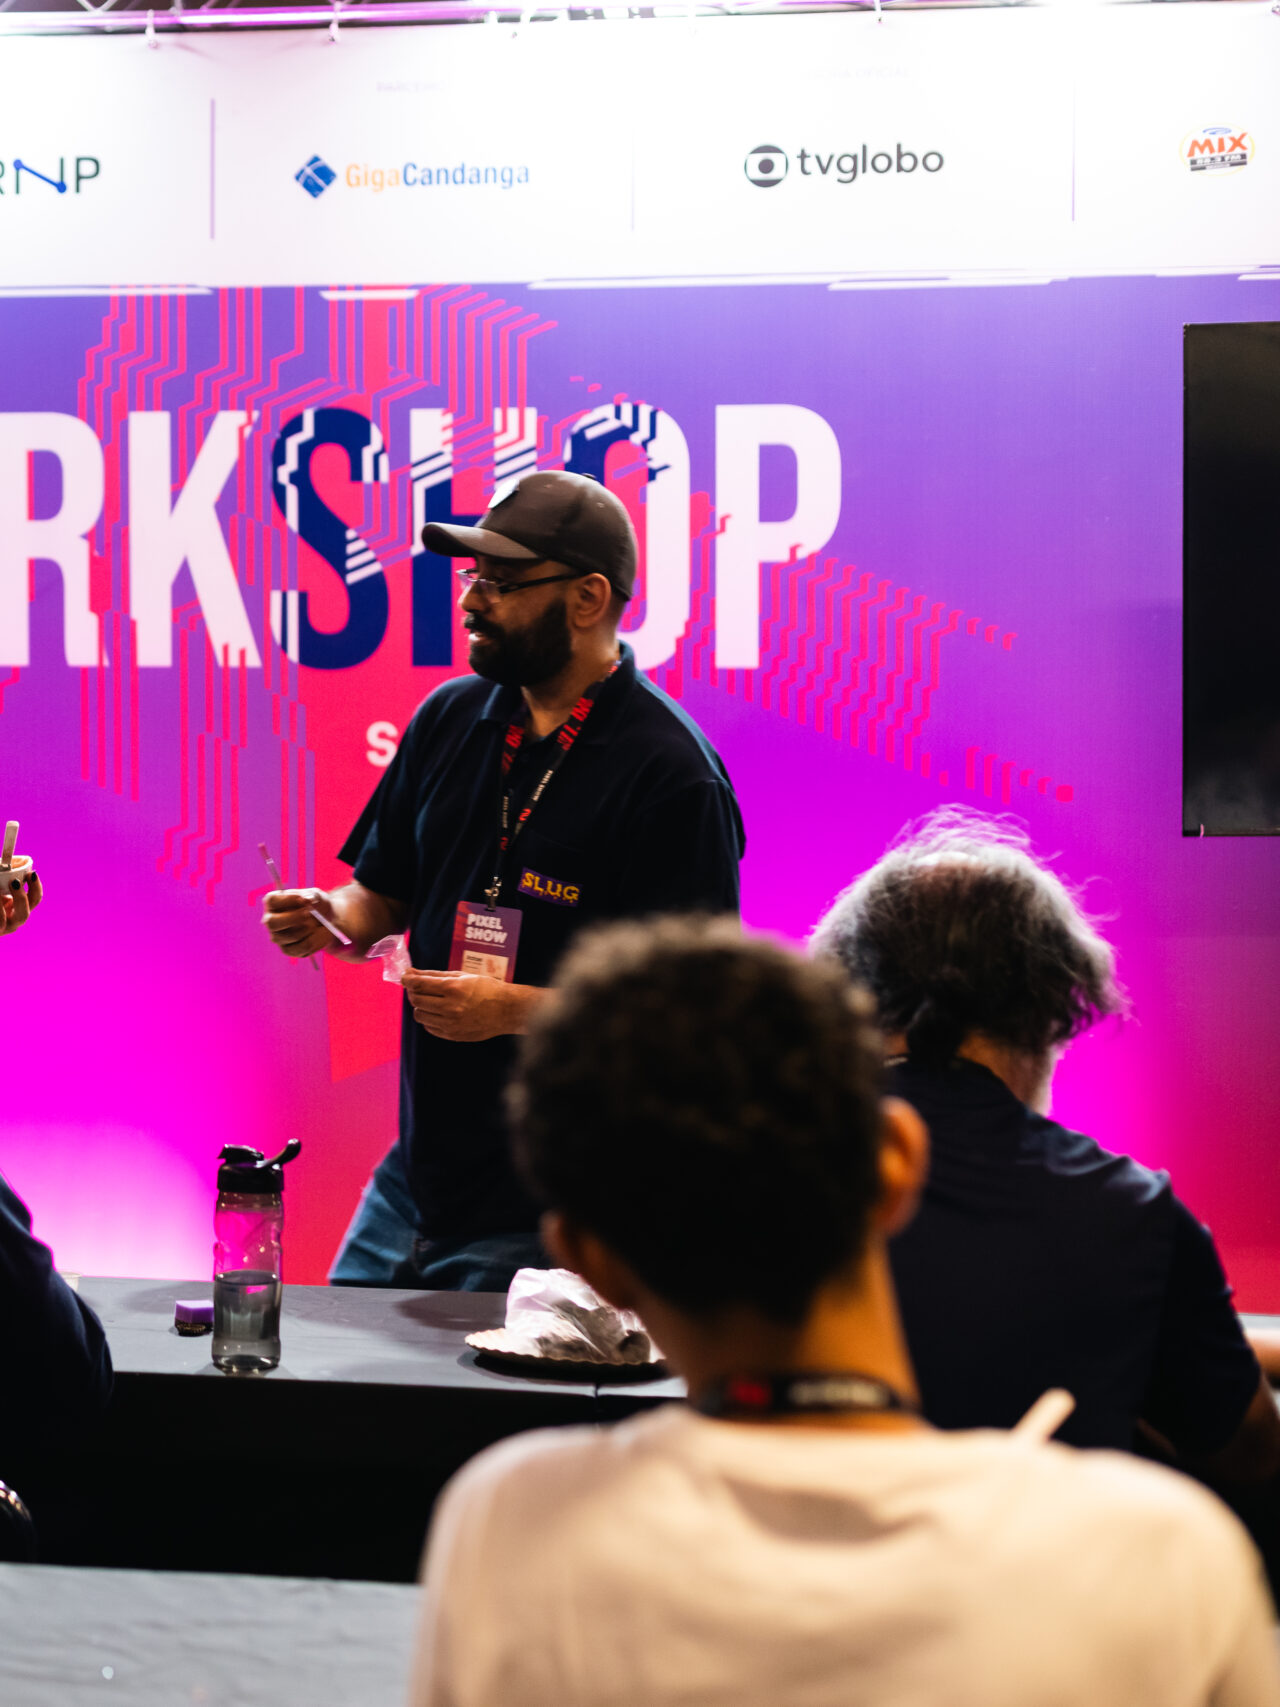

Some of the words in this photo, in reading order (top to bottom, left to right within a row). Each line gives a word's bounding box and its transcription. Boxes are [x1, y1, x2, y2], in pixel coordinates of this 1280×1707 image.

[1187, 132, 1248, 157] MIX
[345, 162, 530, 193] GigaCandanga
[797, 143, 944, 184] tvglobo
[521, 871, 581, 903] SLUG
[464, 926, 508, 944] SHOW
[467, 913, 504, 930] PIXEL
